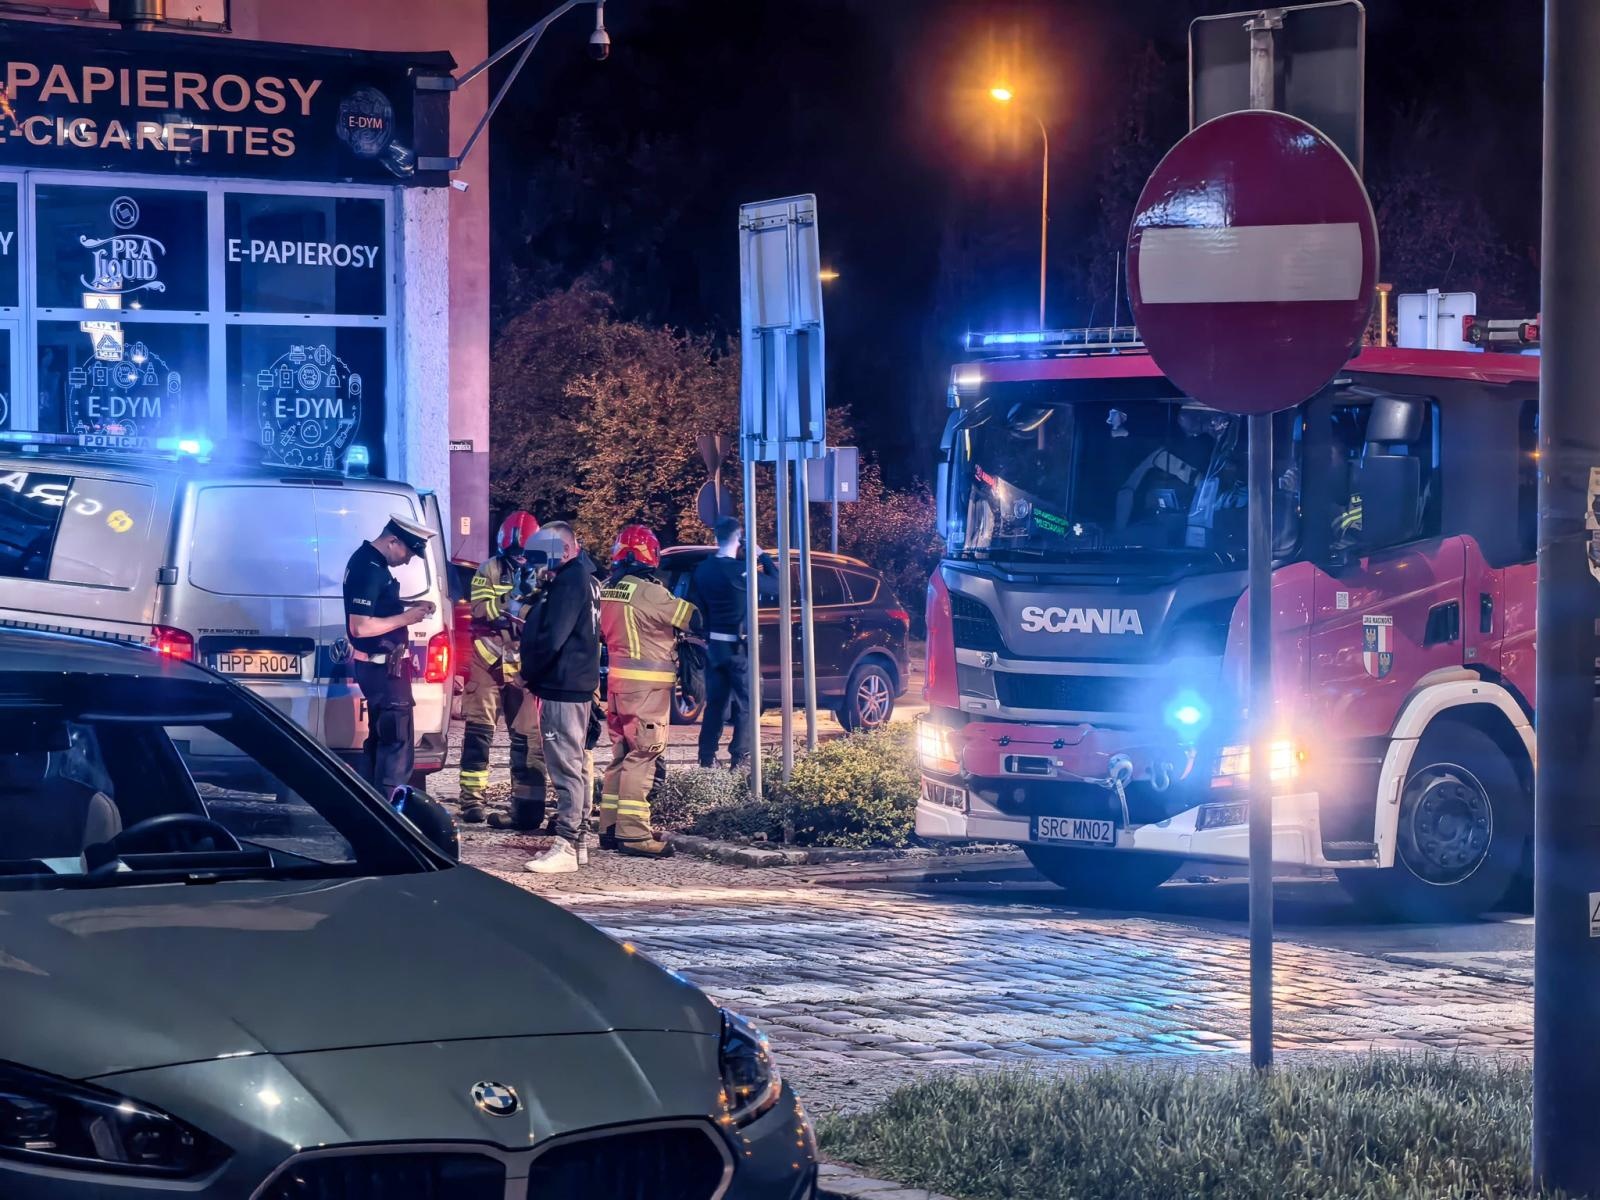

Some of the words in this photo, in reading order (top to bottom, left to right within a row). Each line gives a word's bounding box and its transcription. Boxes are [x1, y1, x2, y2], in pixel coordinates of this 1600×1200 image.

[0, 62, 323, 116] PAPIEROSY
[348, 115, 383, 129] E-DYM
[0, 115, 296, 157] -CIGARETTES
[111, 238, 154, 259] PRA
[228, 239, 379, 269] E-PAPIEROSY
[88, 396, 162, 417] E-DYM
[275, 397, 344, 418] E-DYM
[84, 435, 150, 448] POLICJA
[1020, 606, 1144, 635] SCANIA
[220, 655, 254, 672] HPP
[260, 656, 298, 673] R004
[1041, 818, 1069, 837] SRC
[1073, 821, 1111, 841] MN02
